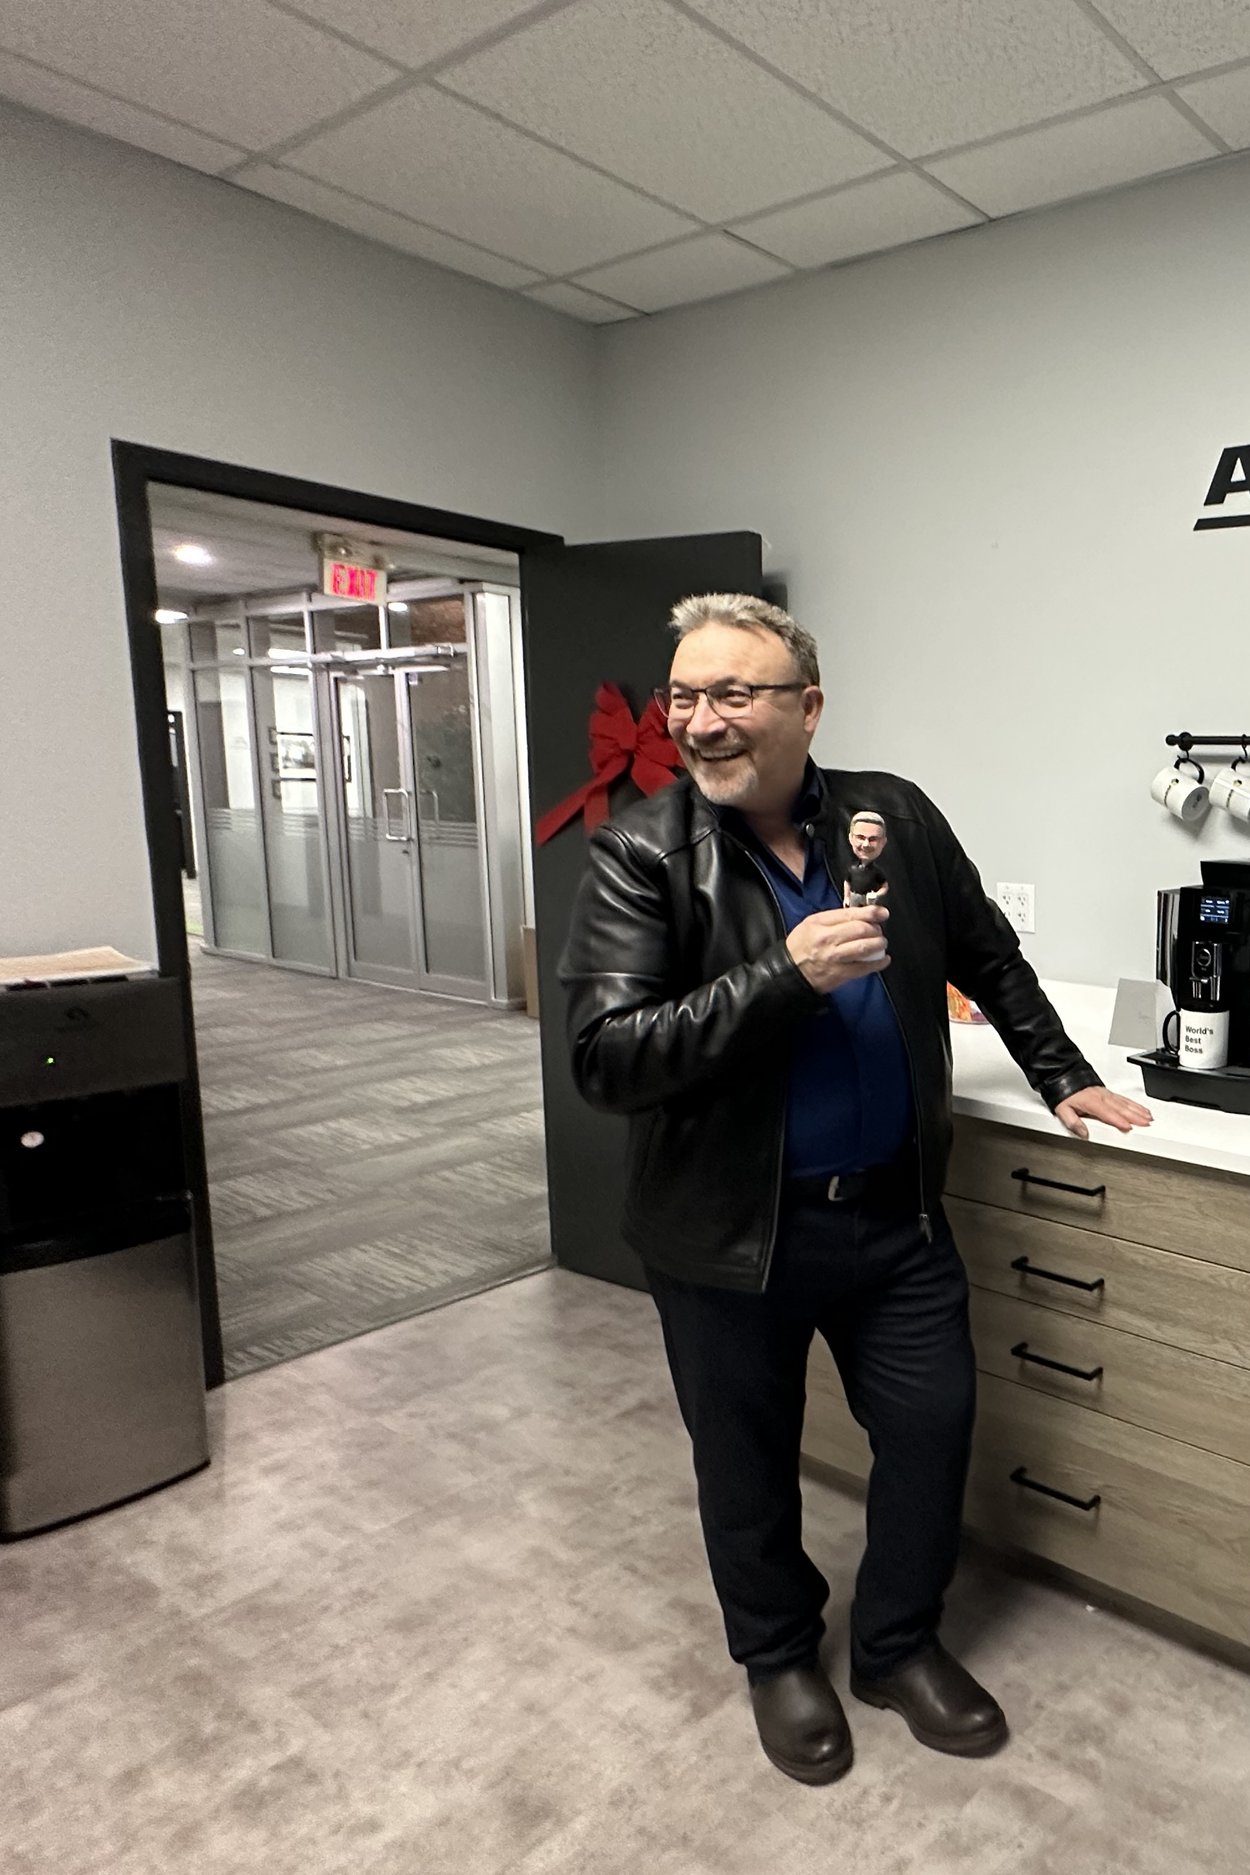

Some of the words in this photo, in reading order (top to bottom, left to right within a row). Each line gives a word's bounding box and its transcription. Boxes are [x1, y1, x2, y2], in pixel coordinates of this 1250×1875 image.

[332, 562, 377, 601] EXIT
[1185, 1026, 1213, 1035] World's
[1185, 1035, 1201, 1044] Best
[1185, 1045, 1203, 1054] Boss
